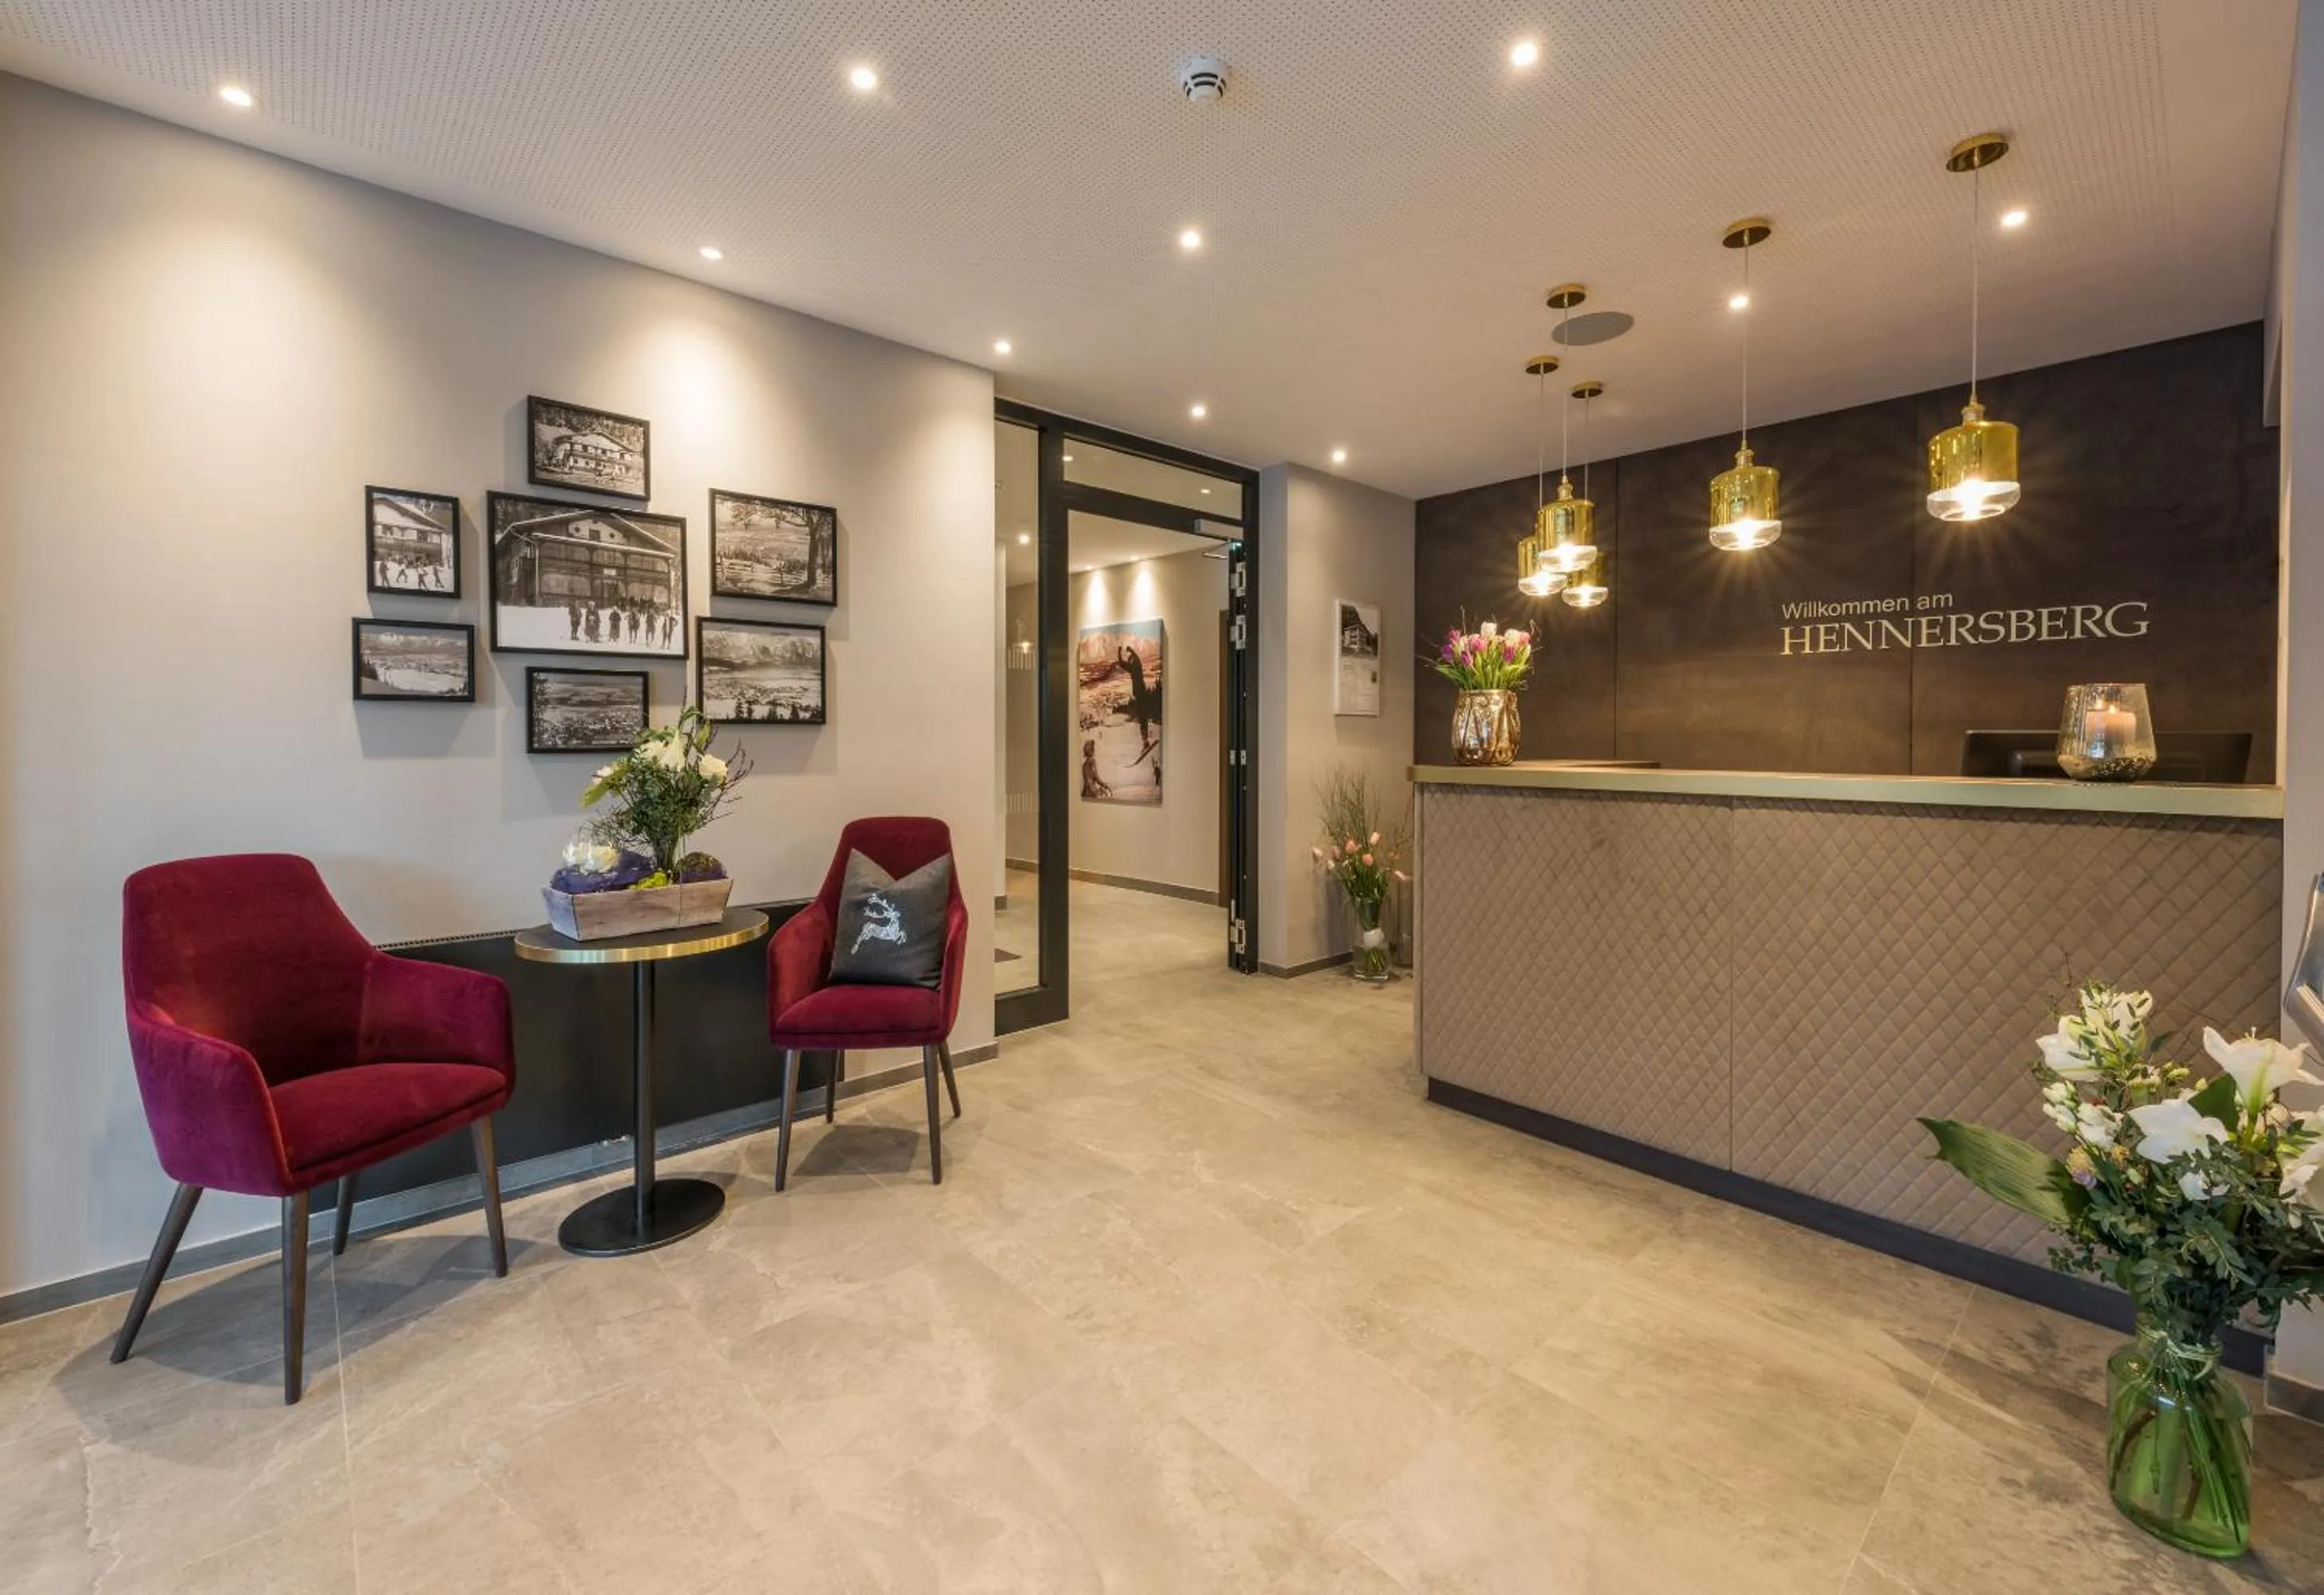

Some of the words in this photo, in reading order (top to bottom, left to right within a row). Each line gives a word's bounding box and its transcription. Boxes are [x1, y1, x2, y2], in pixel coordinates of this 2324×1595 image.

[1782, 598, 1909, 620] Willkommen
[1917, 593, 1953, 610] am
[1779, 601, 2150, 656] HENNERSBERG
